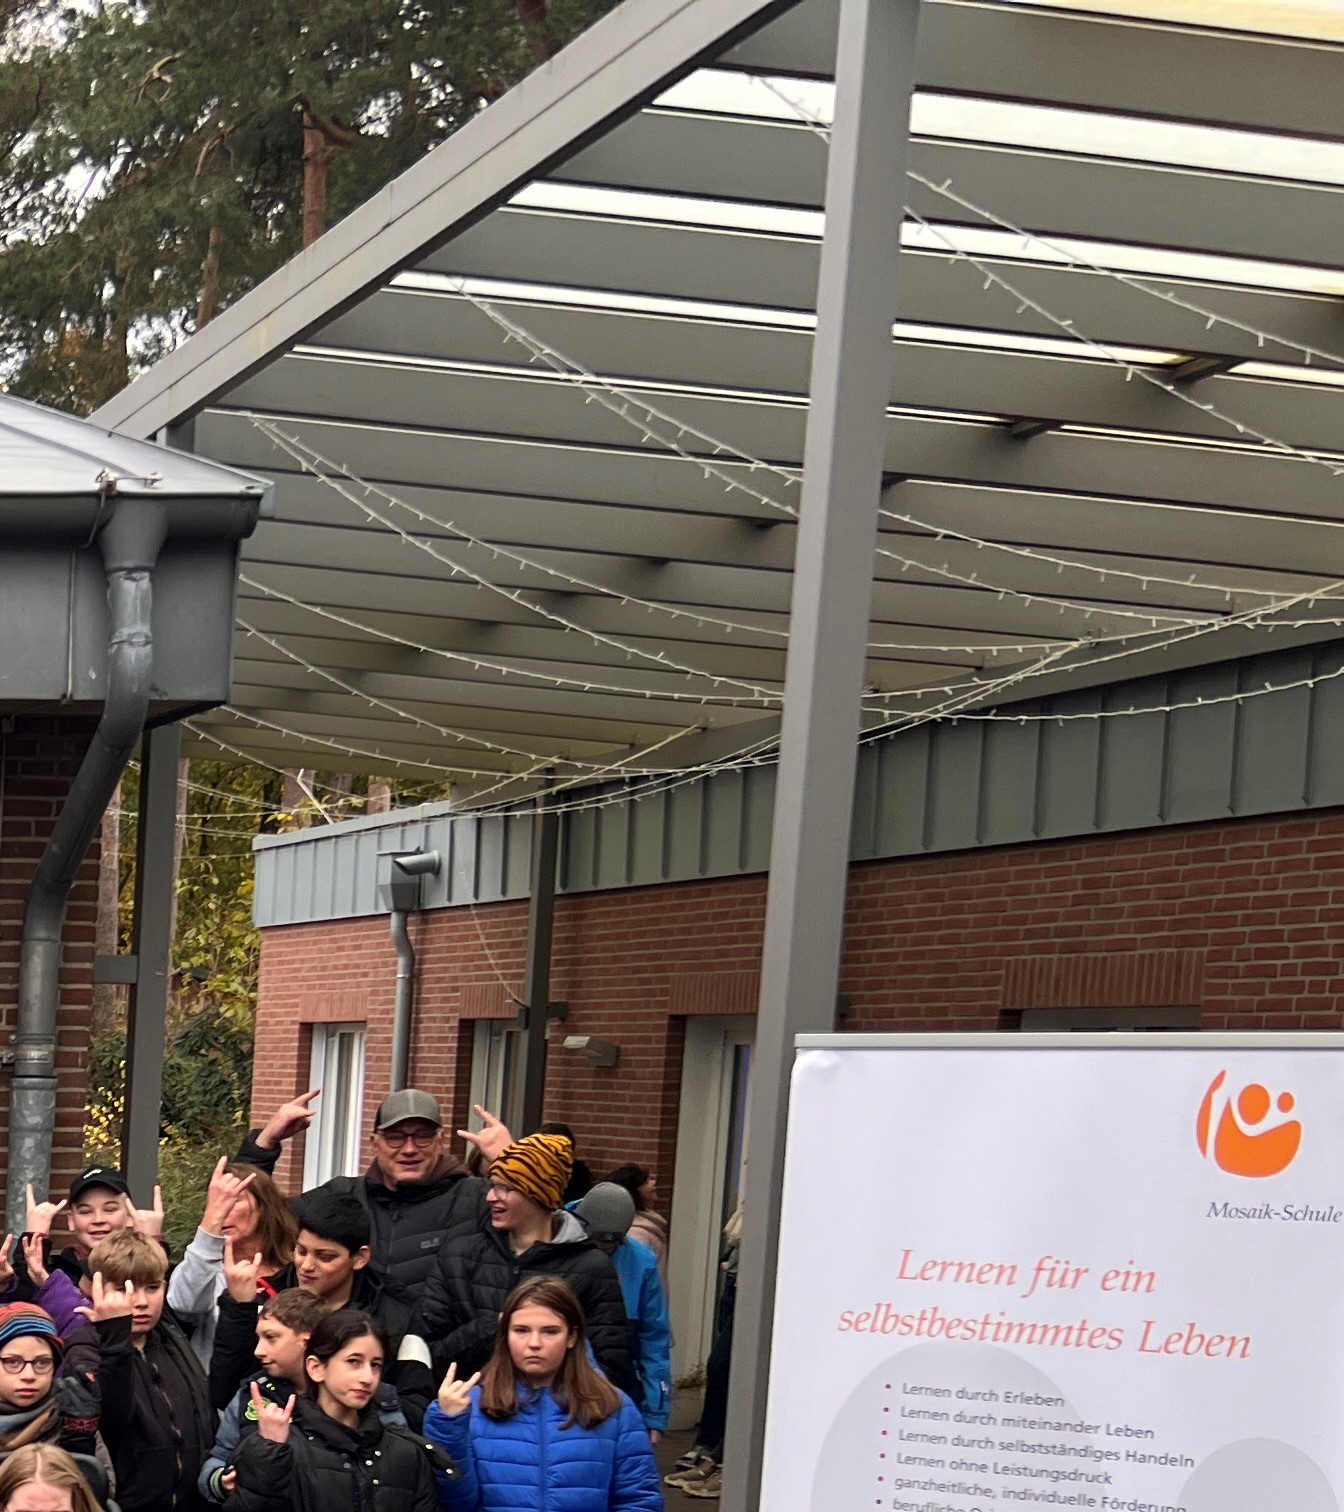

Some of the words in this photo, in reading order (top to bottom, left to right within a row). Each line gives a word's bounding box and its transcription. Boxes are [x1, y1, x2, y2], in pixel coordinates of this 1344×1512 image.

[1206, 1201, 1343, 1223] Mosaik-Schule
[896, 1249, 1017, 1287] Lernen
[1021, 1255, 1090, 1298] für
[1100, 1259, 1156, 1294] ein
[838, 1302, 1124, 1351] selbstbestimmtes
[1137, 1319, 1252, 1359] Leben
[902, 1382, 952, 1398] Lernen
[955, 1386, 999, 1402] durch
[1004, 1390, 1065, 1407] Erleben
[900, 1405, 950, 1421] Lernen
[953, 1410, 997, 1426] durch
[1001, 1415, 1101, 1434] miteinander
[1105, 1423, 1155, 1439] Leben
[898, 1429, 948, 1445] Lernen
[951, 1434, 995, 1450] durch
[998, 1439, 1120, 1462] selbstständiges
[1125, 1450, 1195, 1467] Handeln
[896, 1452, 945, 1469] Lernen
[949, 1458, 988, 1473] ohne
[992, 1462, 1113, 1485] Leistungsdruck
[894, 1477, 997, 1499] ganzheitliche,
[1001, 1486, 1096, 1507] individuelle
